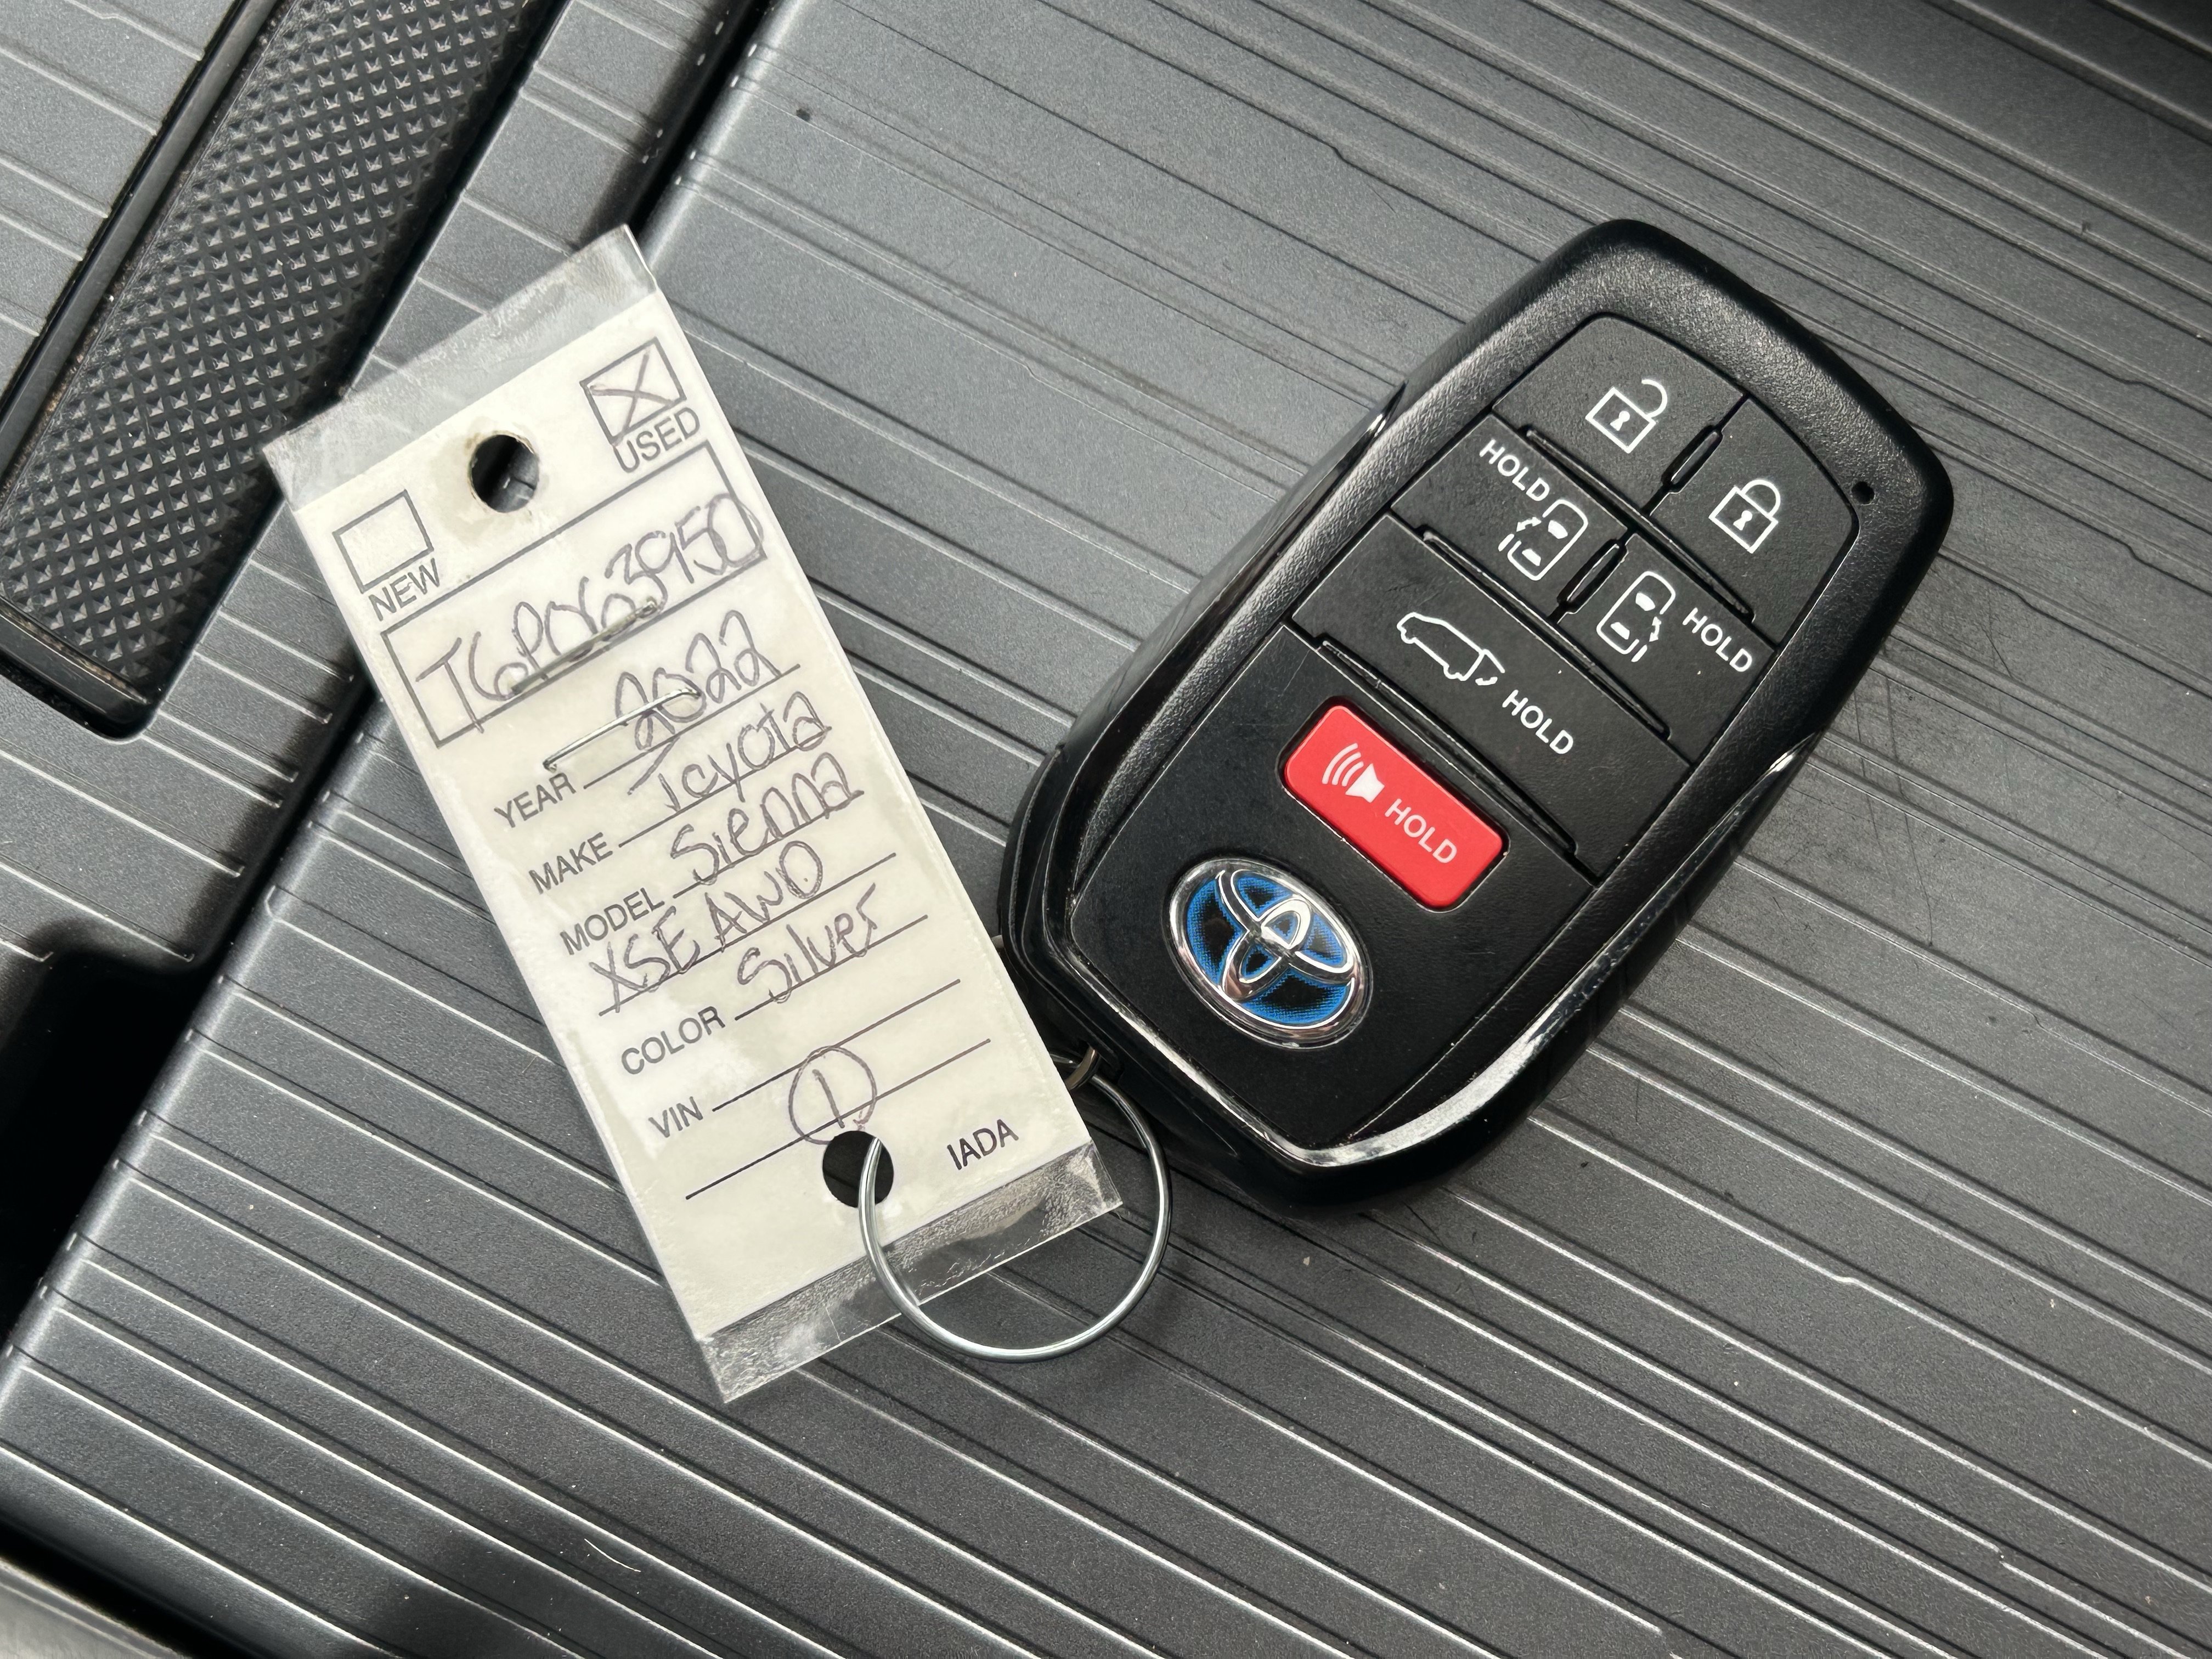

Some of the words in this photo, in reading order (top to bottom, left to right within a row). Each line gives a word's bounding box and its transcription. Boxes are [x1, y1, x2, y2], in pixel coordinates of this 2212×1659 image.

[613, 407, 700, 473] USED
[1479, 439, 1550, 503] HOLD
[367, 558, 440, 621] NEW
[1681, 607, 1753, 673] HOLD
[615, 609, 782, 750] 2022
[627, 691, 830, 812] Toyota
[1502, 689, 1575, 755] HOLD
[494, 773, 577, 828] YEAR
[670, 752, 856, 885] Sienna
[1384, 798, 1458, 865] HOLD
[528, 832, 614, 895] MAKE
[558, 887, 665, 955] MODEL
[588, 906, 701, 1013] XSE
[704, 840, 823, 953] AWD
[736, 882, 878, 1003] Silver
[620, 1005, 726, 1075] COLOR
[648, 1096, 704, 1139] VIN
[811, 1068, 846, 1129] 1
[946, 1118, 1019, 1171] IADA
